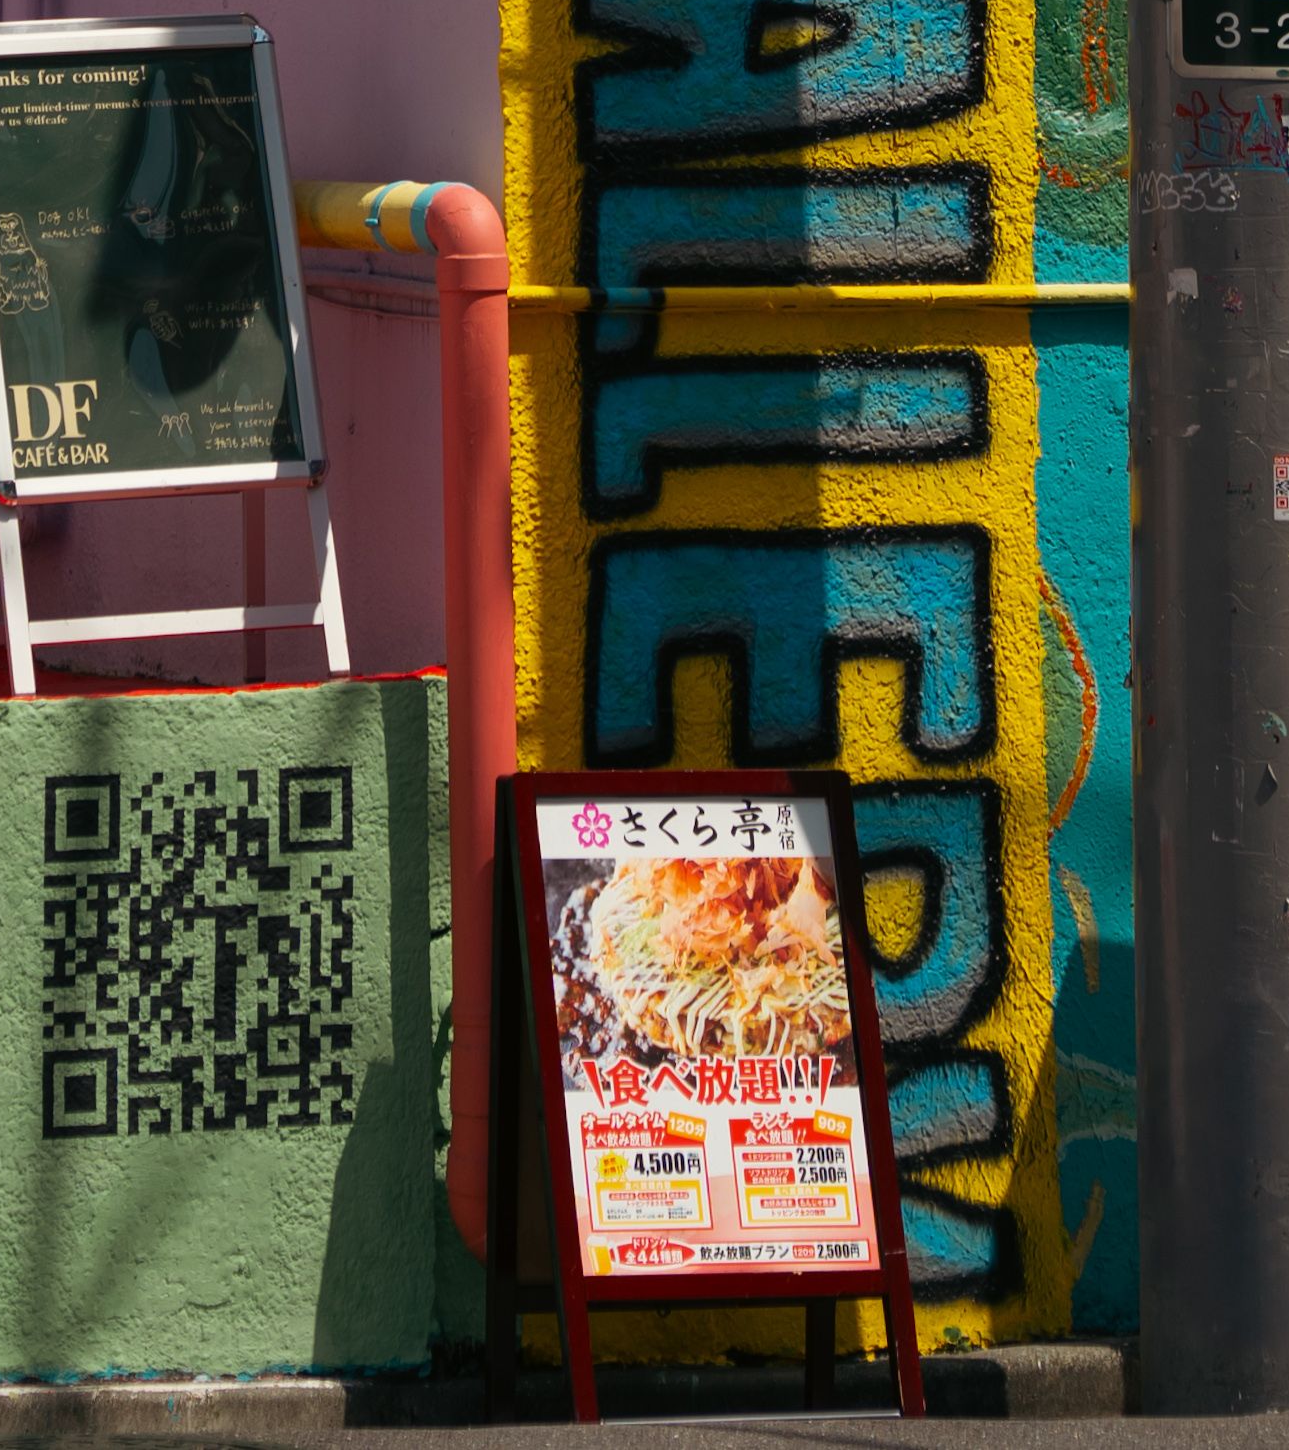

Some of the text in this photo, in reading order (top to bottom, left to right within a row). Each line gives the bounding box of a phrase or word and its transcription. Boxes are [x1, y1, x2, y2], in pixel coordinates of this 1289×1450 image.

[37, 68, 65, 86] for
[72, 64, 148, 86] coming!
[1, 104, 21, 116] our
[23, 100, 91, 115] limited-time
[181, 97, 196, 107] on
[8, 117, 22, 127] us
[24, 113, 69, 128] @dfcafe
[8, 379, 99, 443] DF
[619, 799, 796, 852] さくら亭 原宿
[605, 1056, 817, 1109] 食べ放題!!
[582, 1112, 666, 1130] オールタイム
[668, 1117, 707, 1139] 120分
[750, 1111, 794, 1129] ランチ
[816, 1115, 848, 1135] 90分
[585, 1131, 666, 1149] 食べ飲み放題!!
[744, 1129, 807, 1147] 食べ放題!!
[633, 1151, 702, 1178] 4,500円
[796, 1147, 846, 1165] 2,200円
[798, 1166, 848, 1185] 2,500円
[631, 1236, 669, 1249] ドリンク
[699, 1244, 789, 1262] 飲み放題プラン
[816, 1243, 861, 1260] 2,500円
